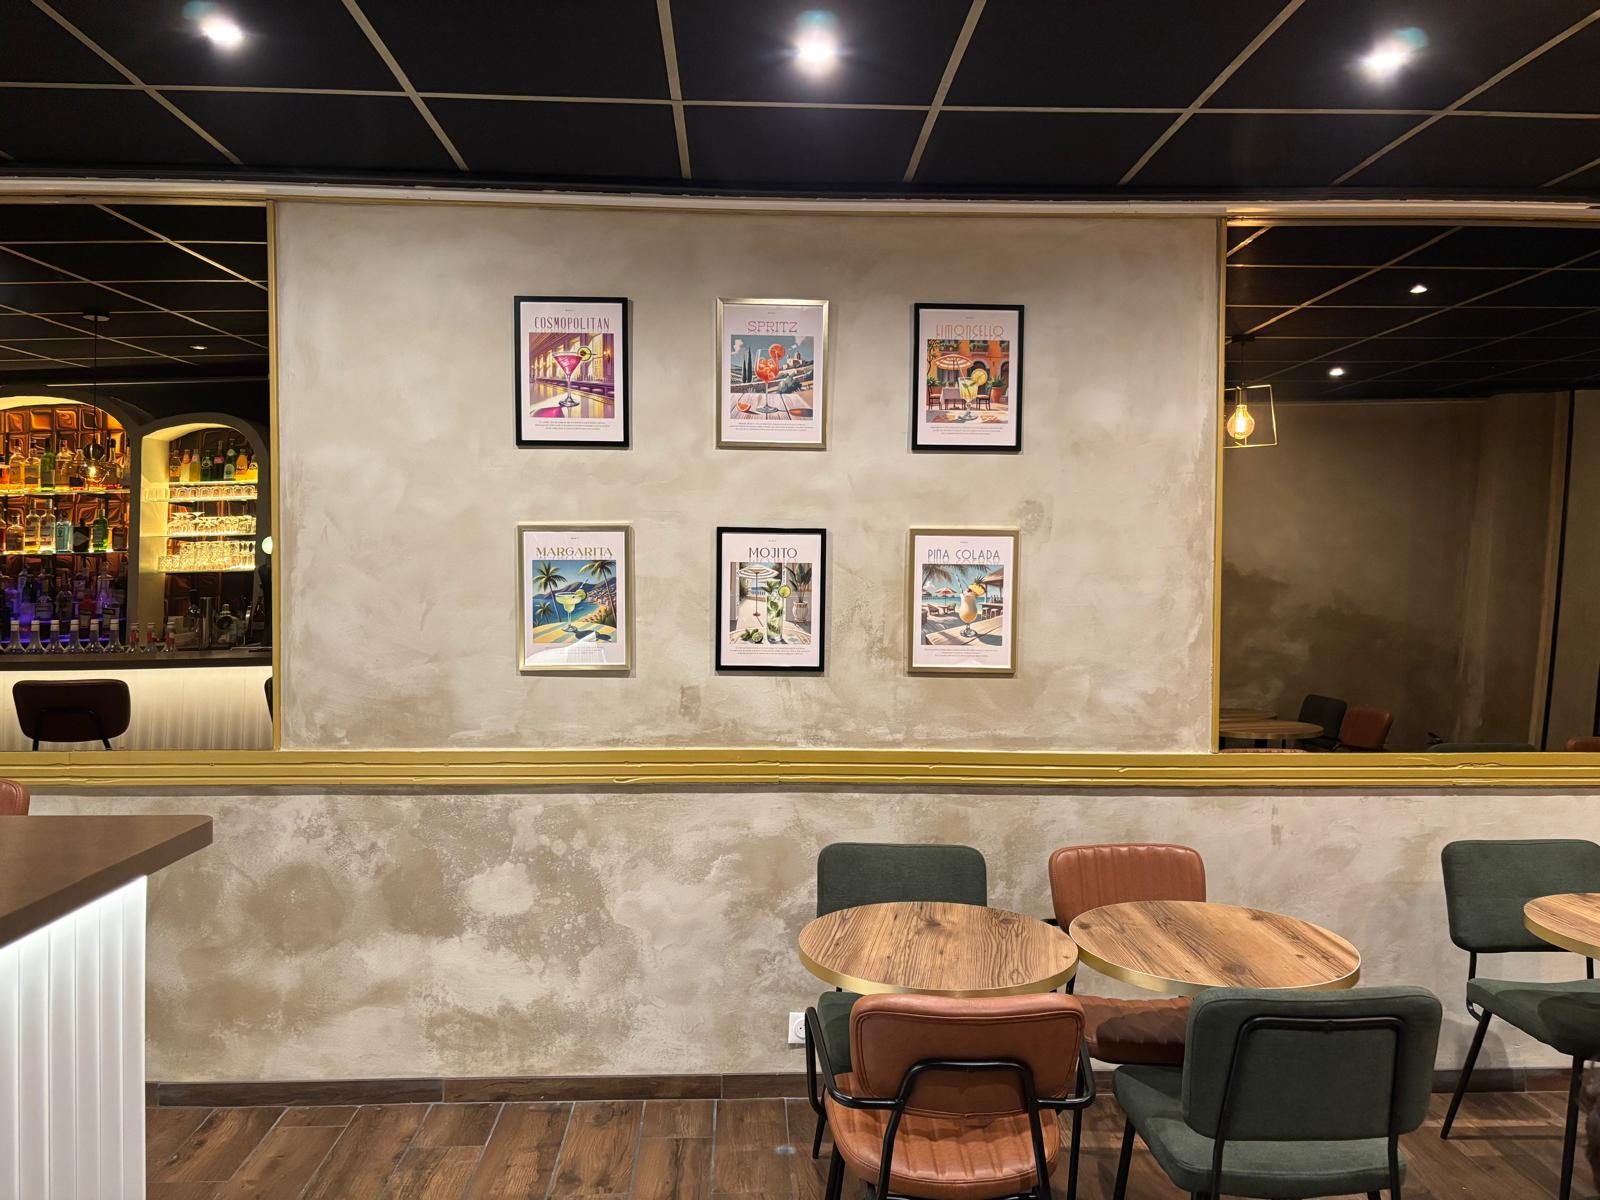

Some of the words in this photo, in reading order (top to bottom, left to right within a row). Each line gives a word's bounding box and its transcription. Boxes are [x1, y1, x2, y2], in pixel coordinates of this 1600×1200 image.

[534, 316, 610, 330] COSMOPOLITAN
[747, 321, 798, 333] SPRITZ
[936, 324, 1004, 338] LIMONCELLO
[536, 547, 613, 557] MARGARITA
[748, 547, 798, 559] MOJITO
[955, 549, 1000, 561] COLADA
